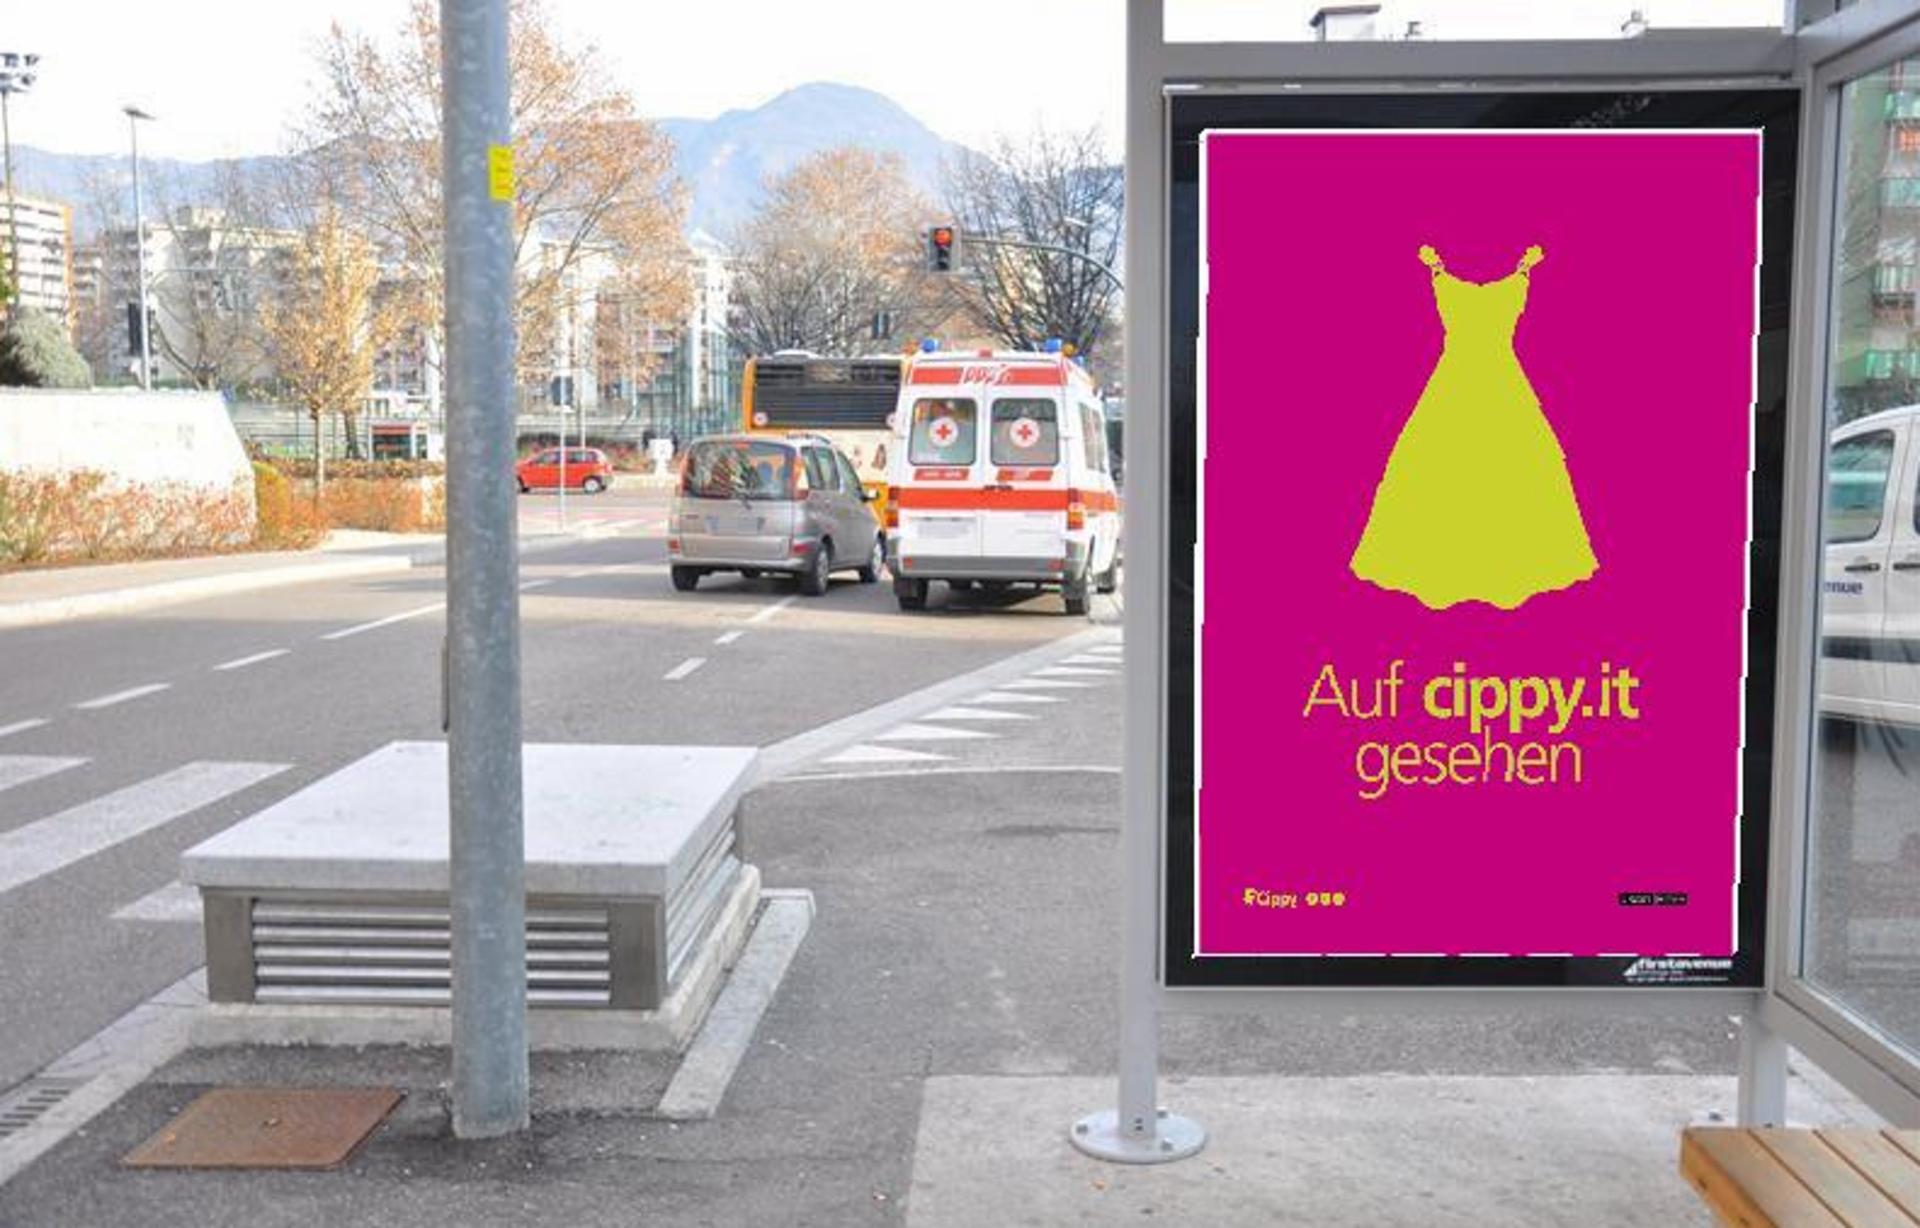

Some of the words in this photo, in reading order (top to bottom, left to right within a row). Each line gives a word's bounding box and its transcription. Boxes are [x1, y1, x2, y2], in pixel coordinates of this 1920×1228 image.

[1303, 659, 1404, 718] Auf
[1423, 661, 1640, 733] cippy.it
[1356, 726, 1581, 800] gesehen
